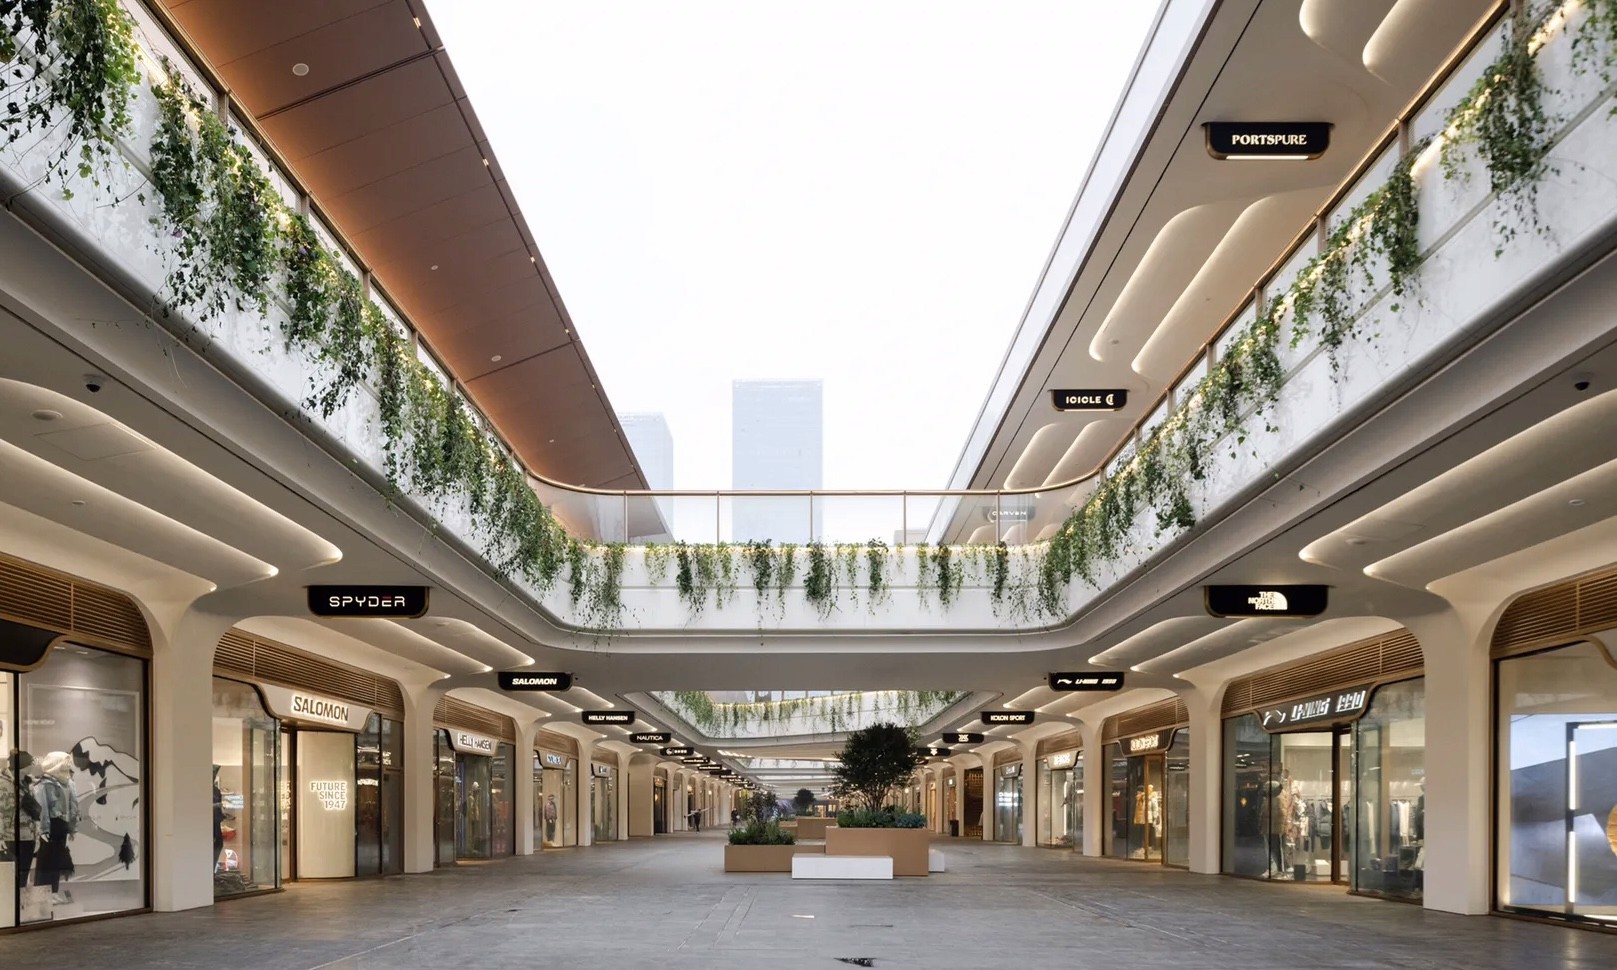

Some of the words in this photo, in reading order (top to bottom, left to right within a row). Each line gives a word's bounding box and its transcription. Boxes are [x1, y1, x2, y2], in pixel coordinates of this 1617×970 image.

[1231, 134, 1307, 145] PORTSPURE
[1065, 396, 1101, 404] ICICLE
[329, 596, 405, 607] SPYDER
[293, 695, 349, 721] SALOMON
[310, 782, 346, 791] FUTURE
[319, 790, 346, 800] SINCE
[324, 800, 346, 809] 1947
